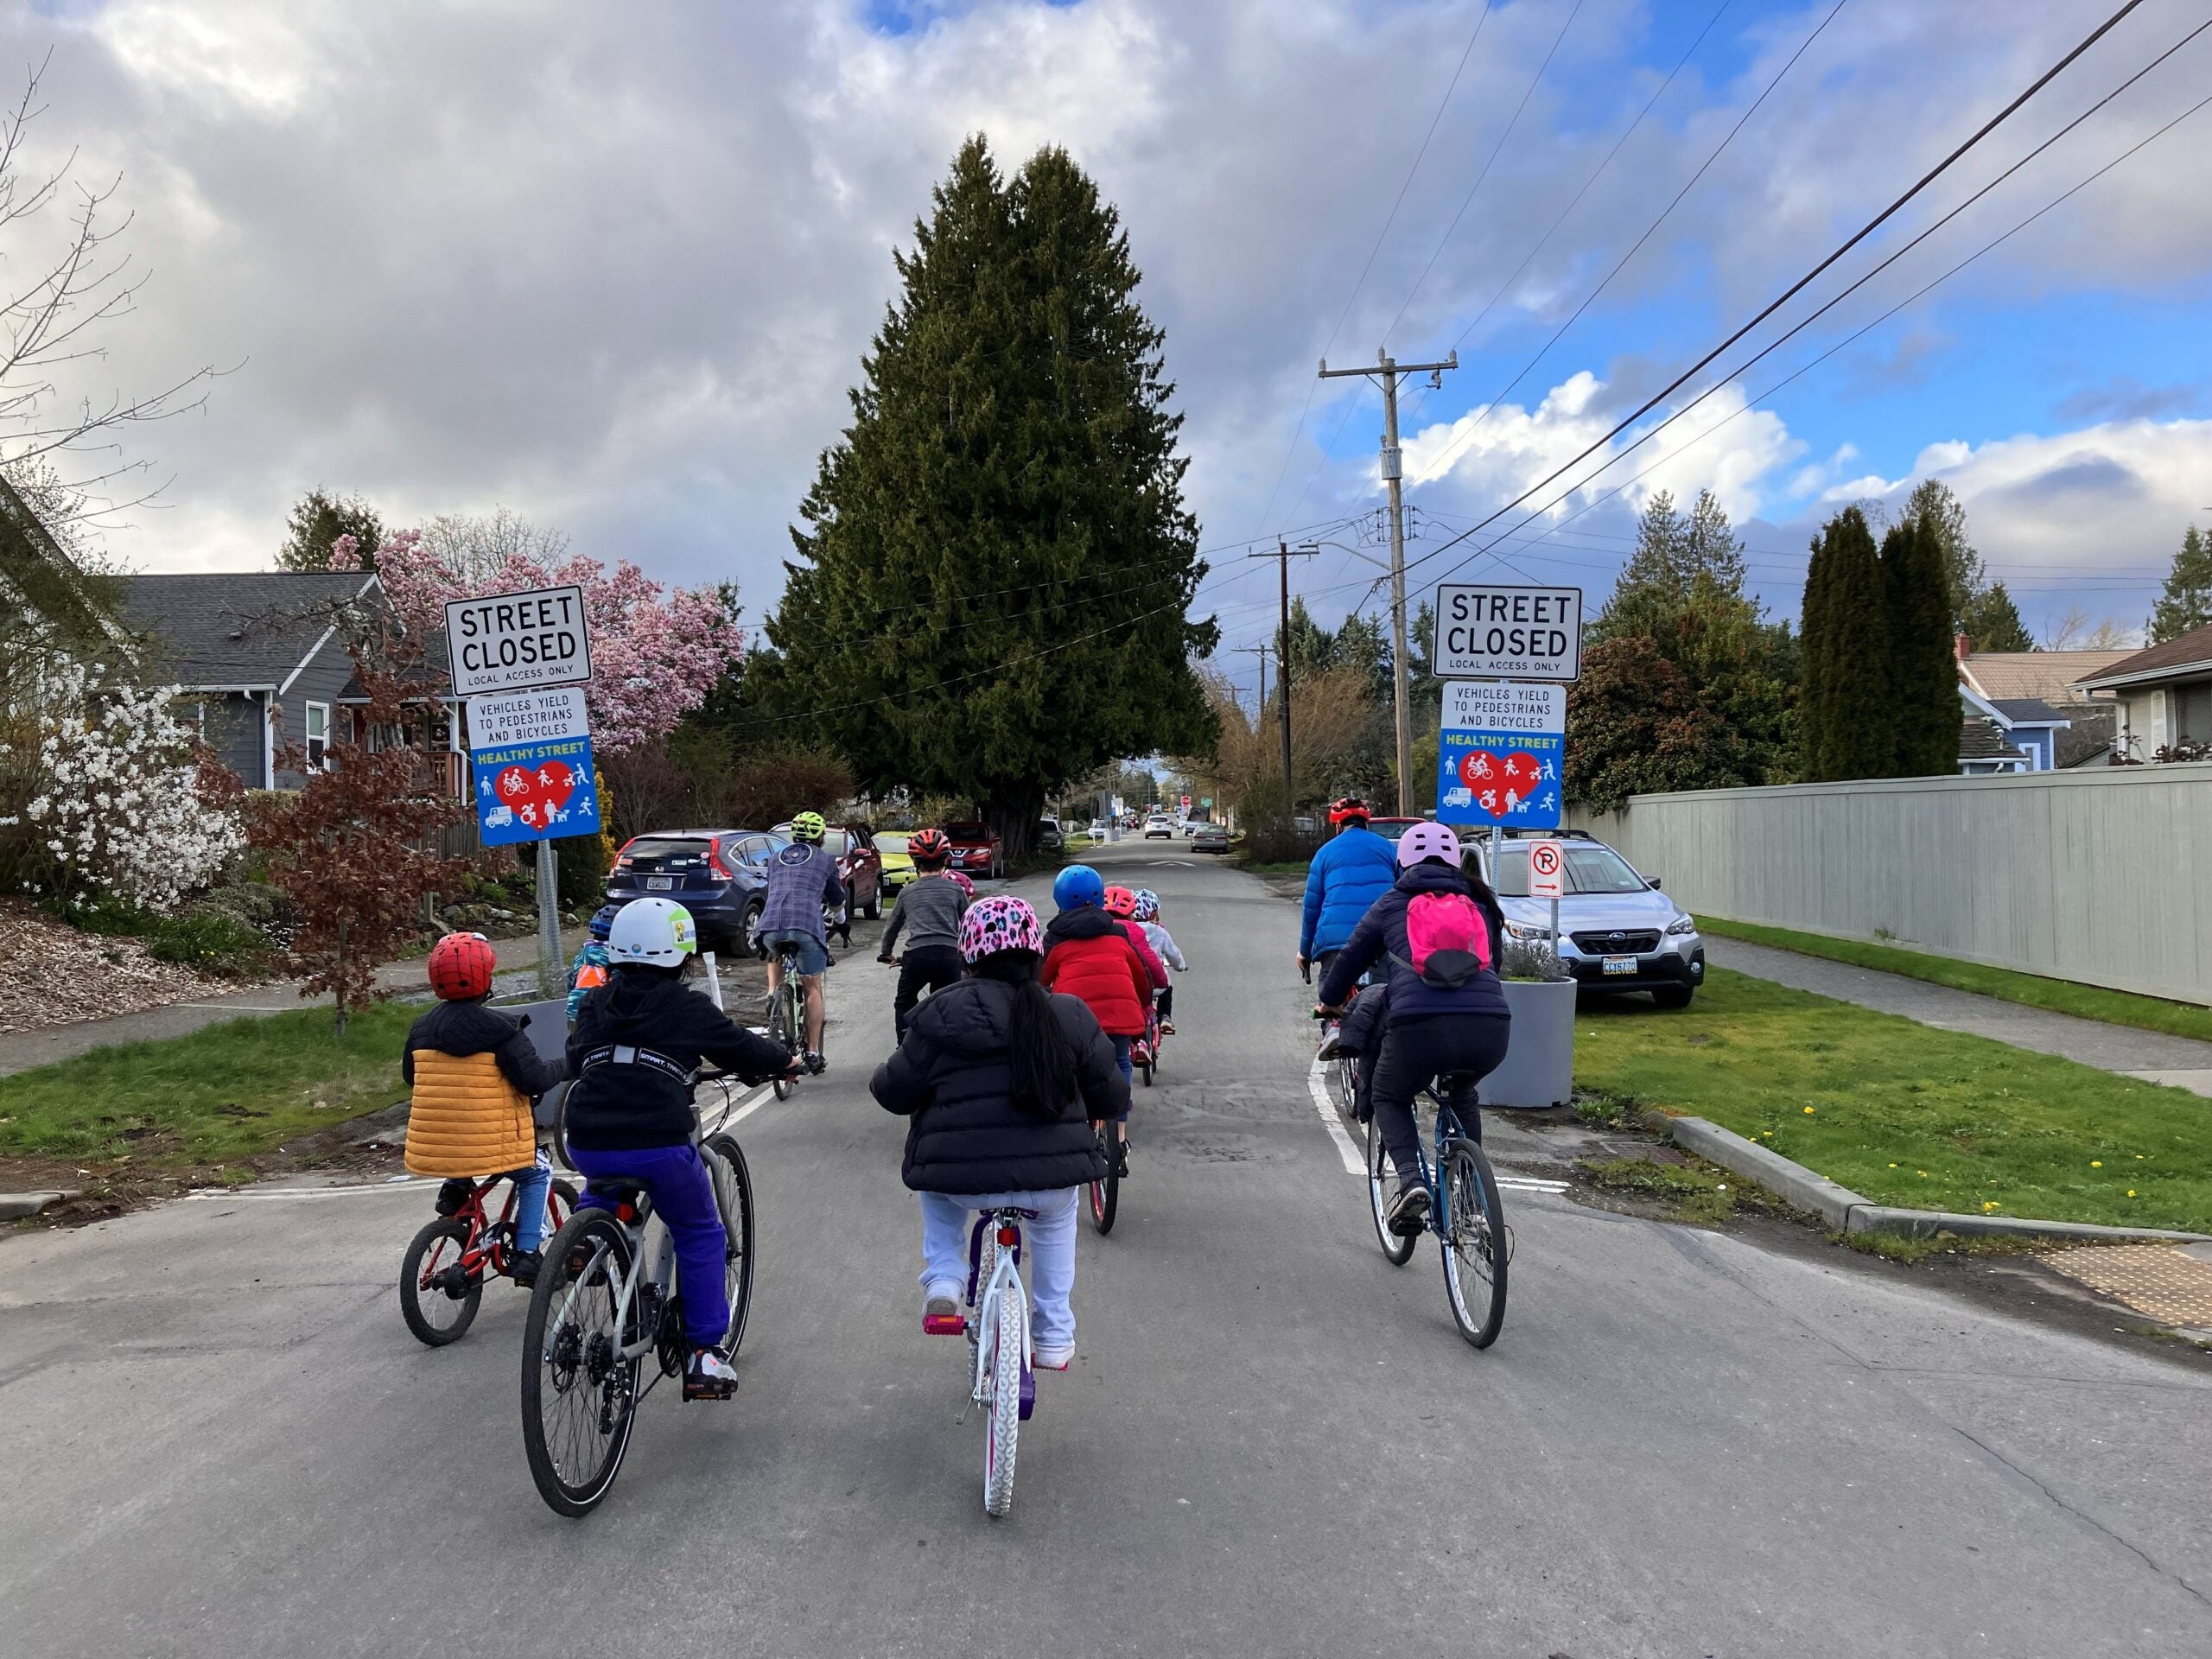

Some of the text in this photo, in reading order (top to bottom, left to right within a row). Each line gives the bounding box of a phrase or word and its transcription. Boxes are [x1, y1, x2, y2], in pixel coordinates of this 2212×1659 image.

[461, 596, 573, 637] STREET
[1452, 593, 1571, 624] STREET
[462, 632, 576, 671] CLOSED
[1447, 626, 1567, 657] CLOSED
[468, 664, 574, 686] LOCAL ACCESS ONLY
[1449, 659, 1561, 671] LOCAL ACCESS ONLY
[1457, 688, 1549, 702] VEHICLES YIELD
[480, 695, 569, 716] VEHICLES YIELD
[1454, 701, 1551, 715] TO PEDESTRIANS
[480, 709, 573, 730] TO PEDESTRIANS
[1460, 715, 1543, 728] AND BICYCLES
[488, 723, 568, 743] AND BICYCLES
[1446, 734, 1559, 749] HEALTHY STREET
[477, 741, 585, 766] HEALTHY STREET
[1541, 853, 1553, 869] P
[640, 1052, 666, 1068] SMART,
